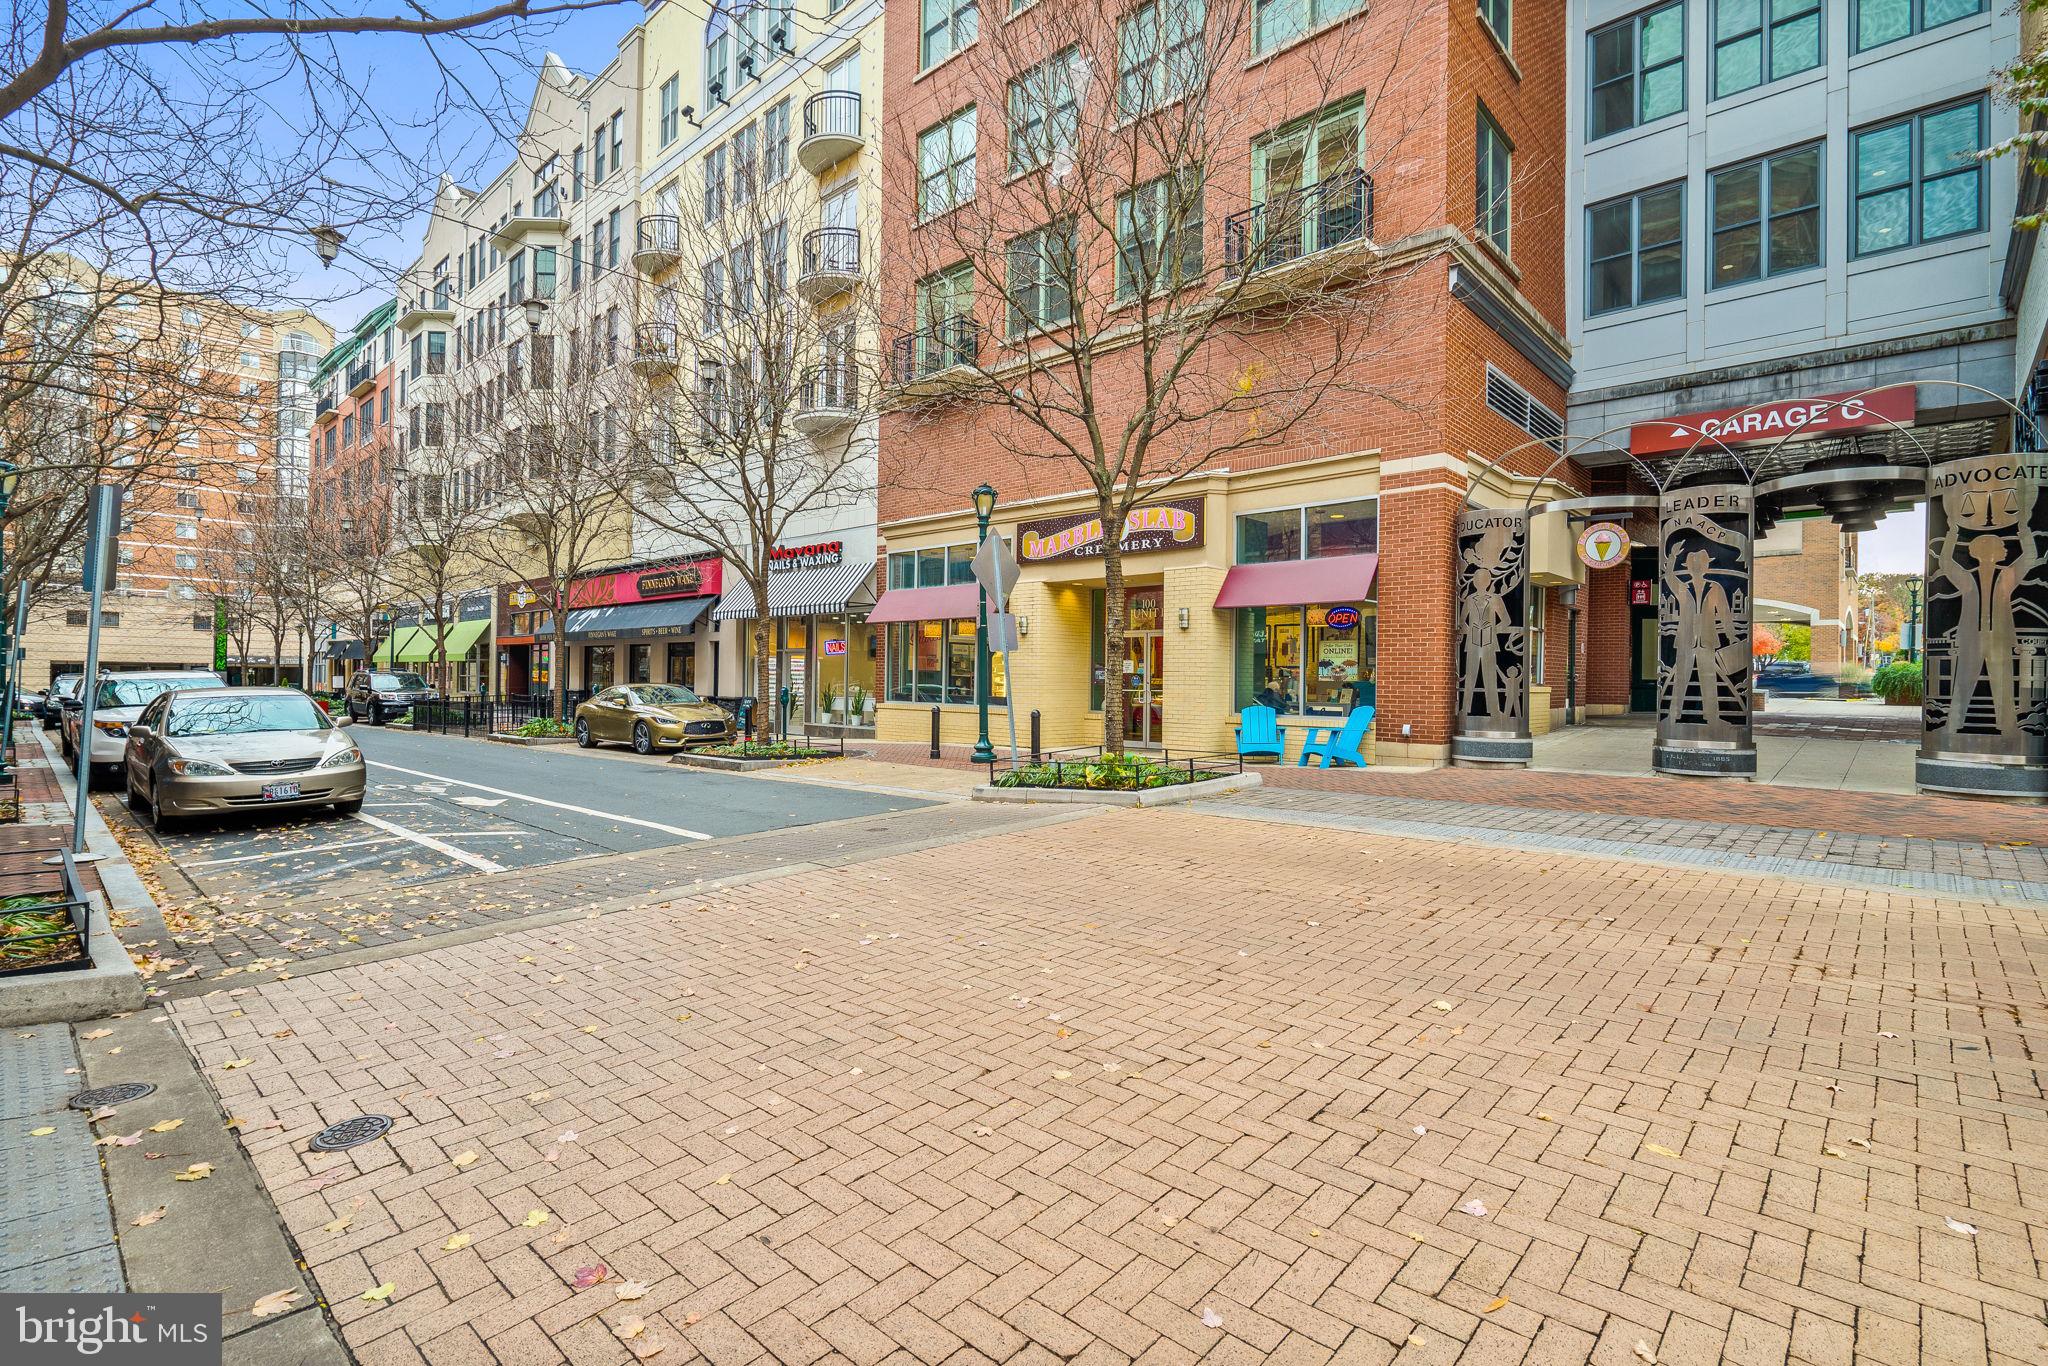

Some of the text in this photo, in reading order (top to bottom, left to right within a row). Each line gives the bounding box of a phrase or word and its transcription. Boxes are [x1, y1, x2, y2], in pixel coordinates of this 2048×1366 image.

[1700, 400, 1865, 437] GARAGE C
[1934, 465, 2048, 490] ADVOCATE
[1666, 495, 1739, 514] LEADER
[1029, 509, 1186, 558] MARBL SLAB
[1674, 516, 1726, 539] NAACP
[1074, 537, 1164, 556] CREMERY
[769, 553, 838, 571] NAILS & WAXING
[641, 574, 676, 590] FINNEGAN'S
[1133, 608, 1160, 618] UNIT
[1142, 599, 1156, 609] 100
[1328, 612, 1359, 624] OPEN
[826, 642, 846, 653] NAILS
[1323, 647, 1353, 655] ONLINE!
